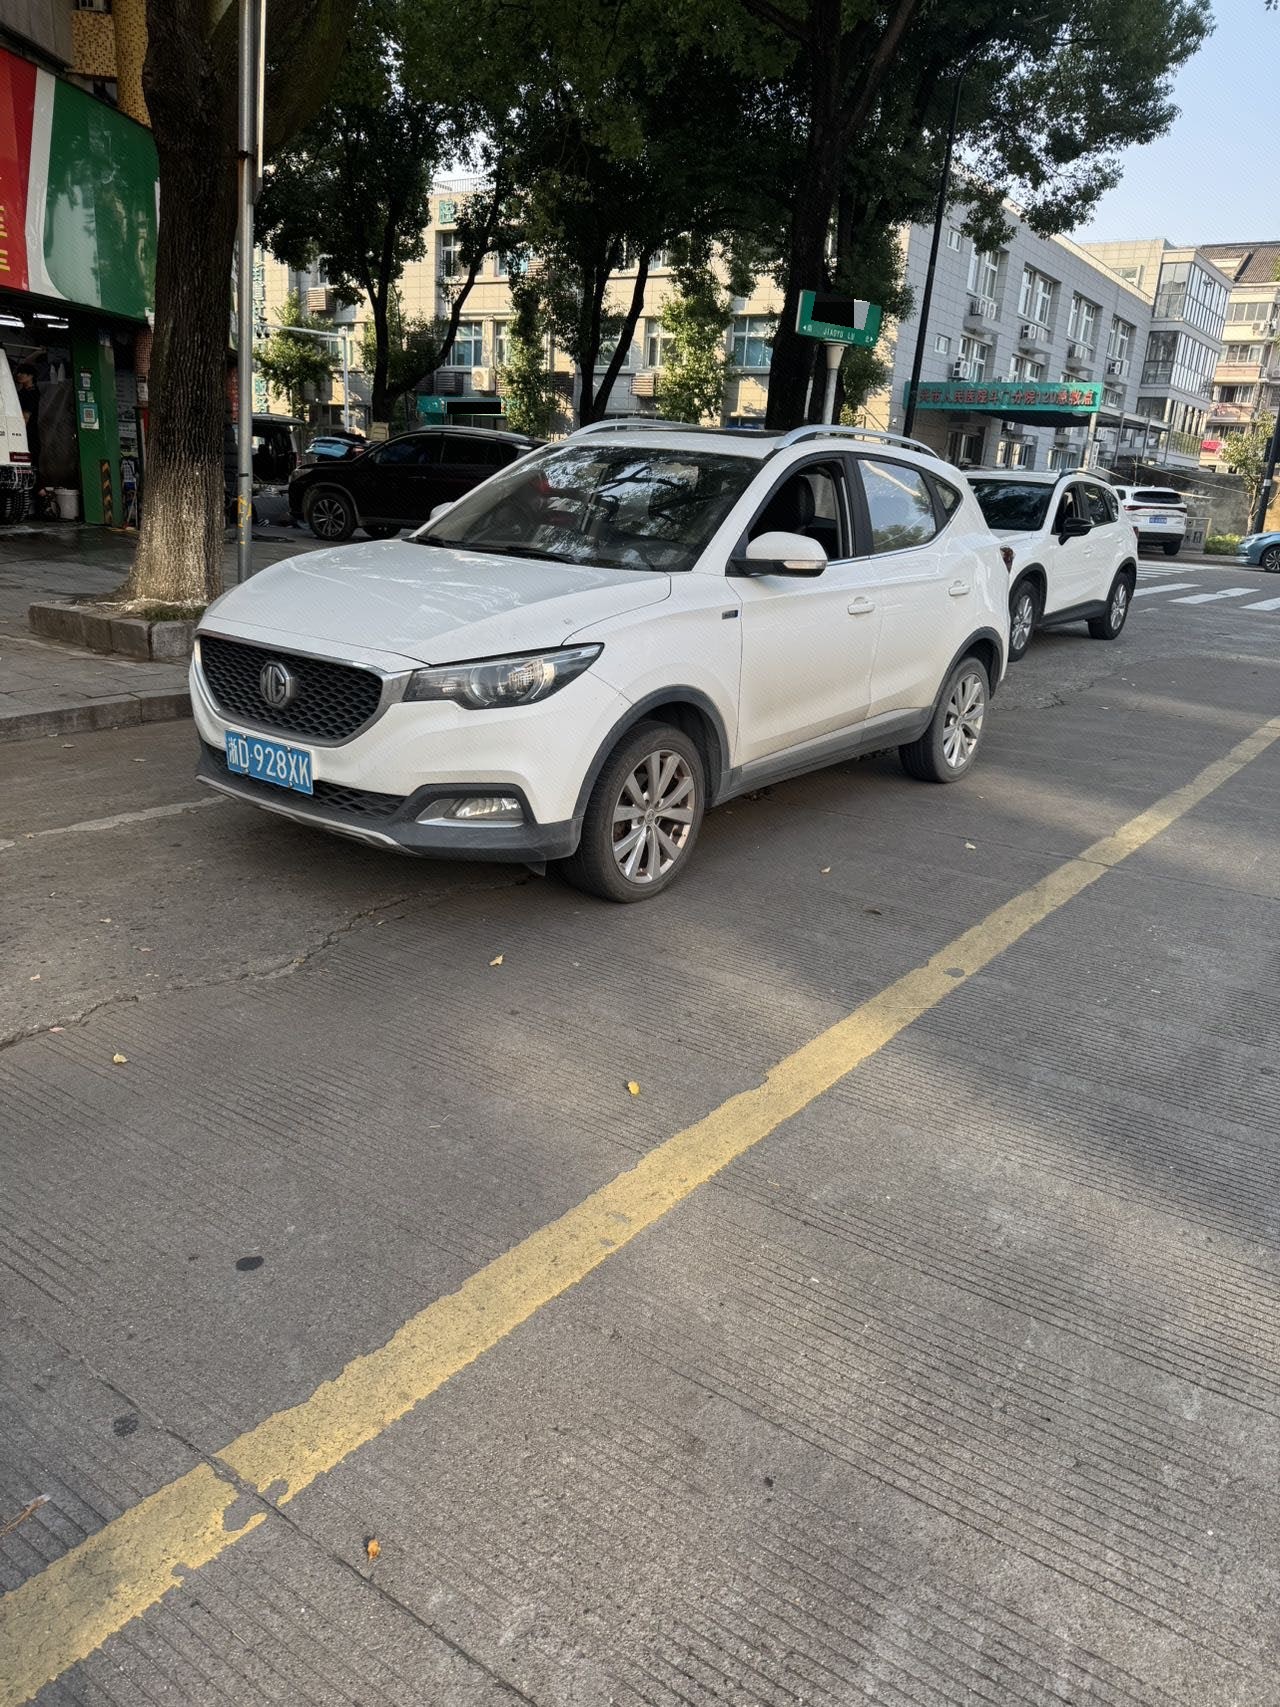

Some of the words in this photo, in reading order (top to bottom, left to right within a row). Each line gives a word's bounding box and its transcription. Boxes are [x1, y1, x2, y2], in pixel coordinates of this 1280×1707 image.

[918, 388, 1094, 407] 兴市人民医院斗门分院120急救点
